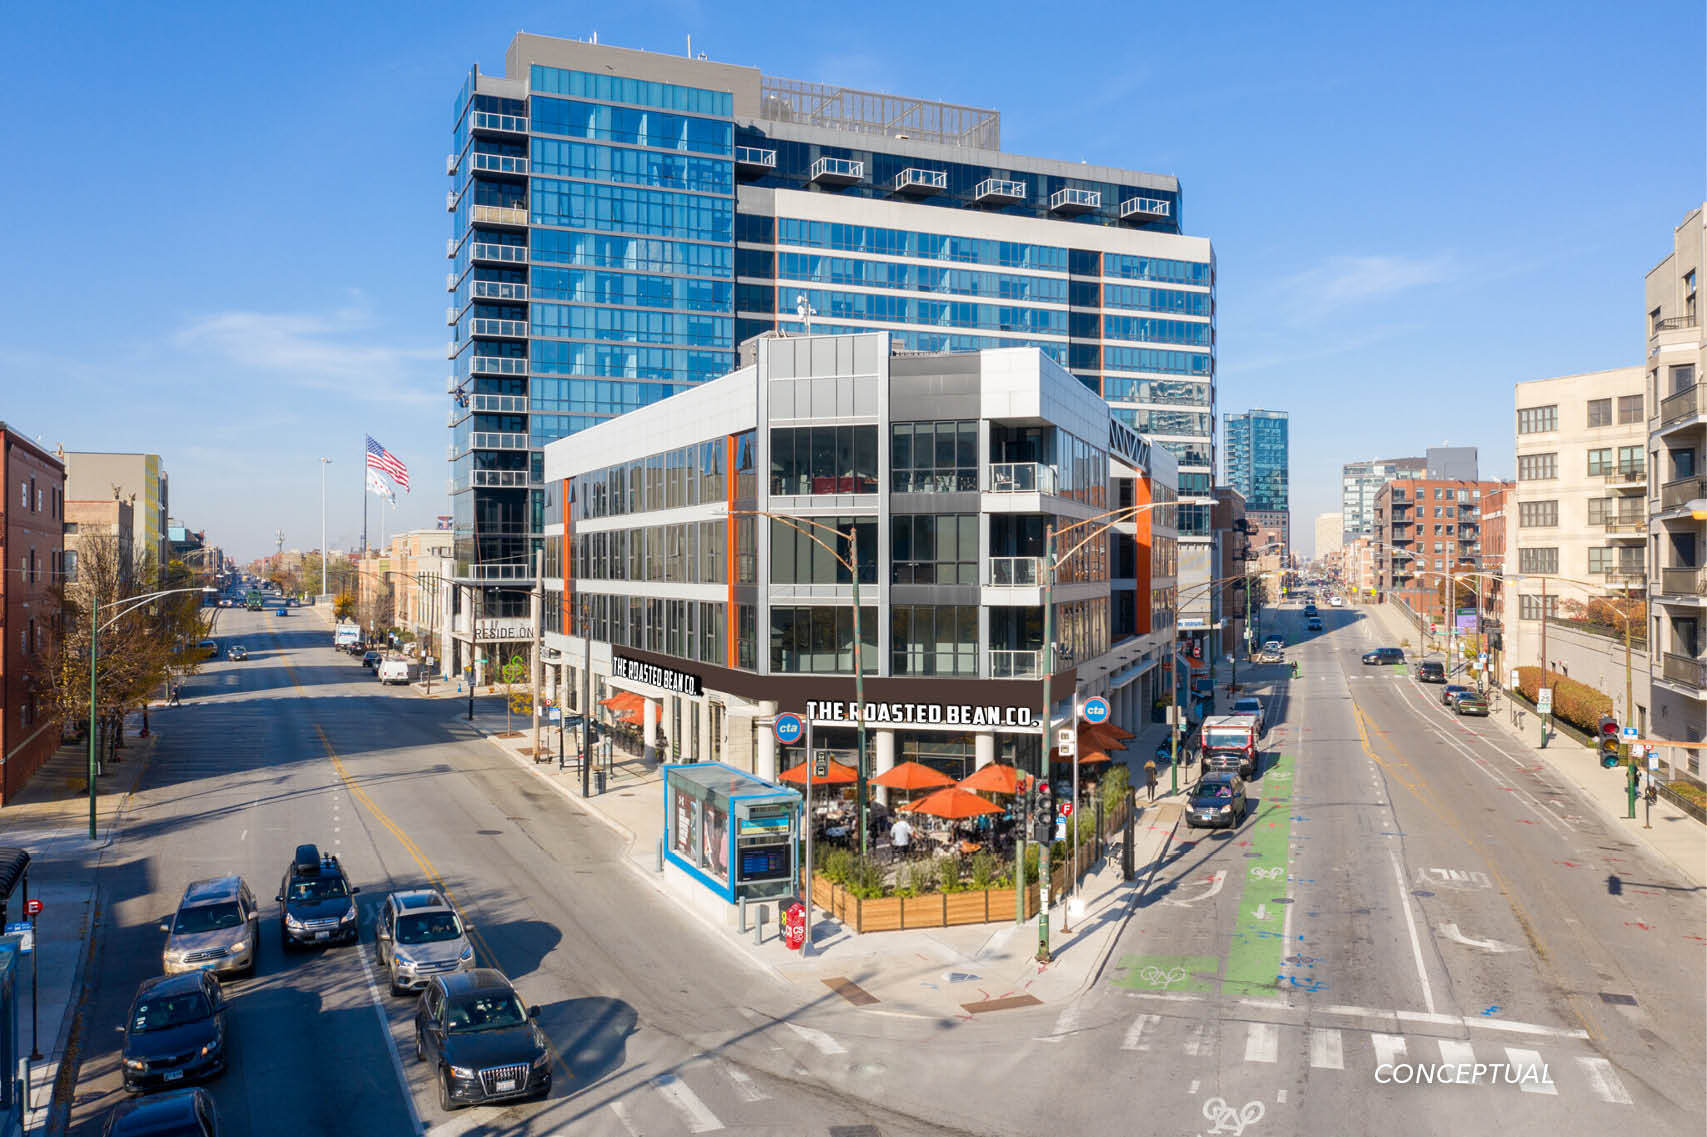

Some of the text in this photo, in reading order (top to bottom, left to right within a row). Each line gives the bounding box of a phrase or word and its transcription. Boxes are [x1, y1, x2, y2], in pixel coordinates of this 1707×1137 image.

[474, 626, 534, 639] RESIDE ON
[613, 656, 697, 695] THE ROASTED BEAN CO.
[807, 701, 1039, 727] THE ROASTED BEAN CO.
[1087, 706, 1105, 716] cta
[779, 722, 797, 733] cta
[1063, 804, 1070, 814] F
[28, 901, 39, 913] E
